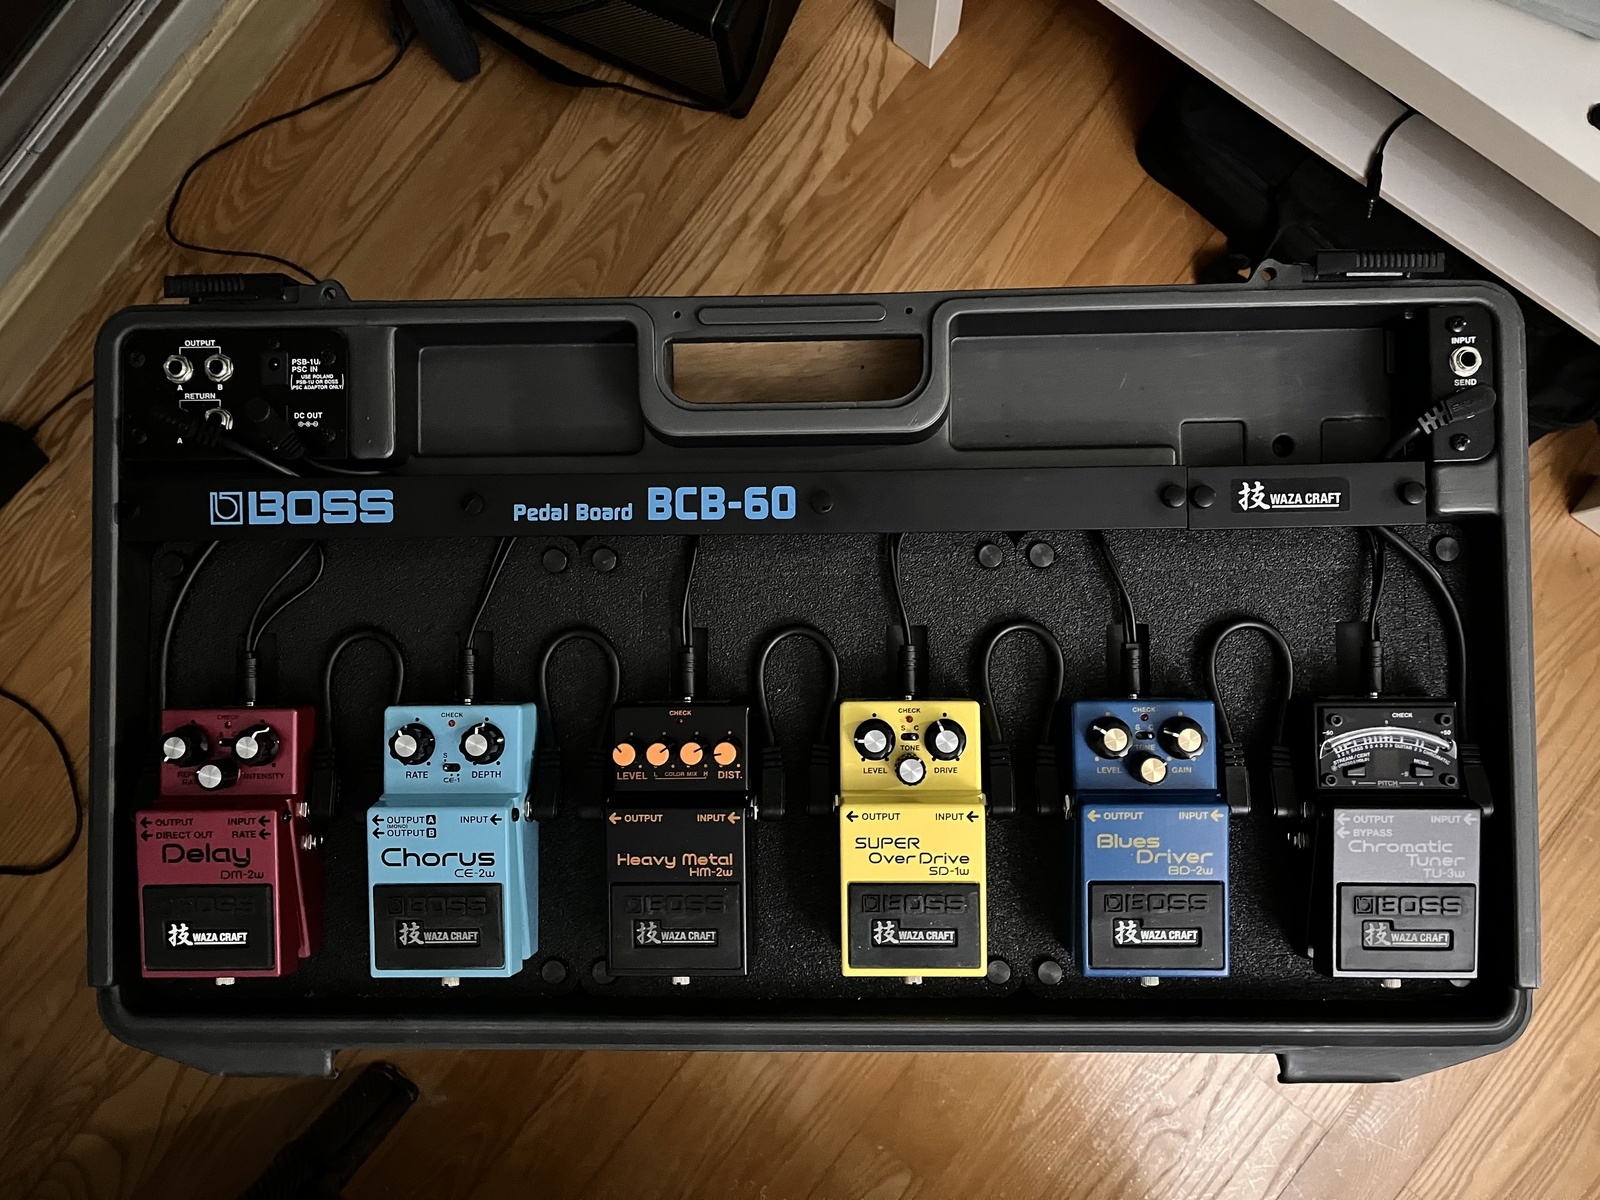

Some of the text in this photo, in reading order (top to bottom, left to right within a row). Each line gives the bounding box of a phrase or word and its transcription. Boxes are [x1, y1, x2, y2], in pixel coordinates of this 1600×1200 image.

[1451, 336, 1476, 344] INPUT
[1454, 378, 1477, 386] SEND
[1238, 480, 1270, 510] 技
[1270, 492, 1341, 504] WAZA CRAFT
[248, 490, 394, 524] BOSS
[513, 486, 796, 522] Pedal Board BCB-60
[617, 772, 648, 780] LEVEL
[718, 771, 743, 779] DIST.
[155, 818, 194, 826] OUTPUT
[228, 818, 256, 826] INPUT
[862, 813, 900, 821] OUTPUT
[156, 831, 213, 839] DIRECT OUT
[1097, 834, 1160, 848] Blues
[855, 837, 920, 849] SUPER
[1348, 840, 1453, 853] Chromatic
[162, 843, 250, 868] Delay
[381, 848, 495, 867] Chorus
[617, 853, 733, 869] Heavy Metal
[1137, 850, 1213, 864] Driver
[1405, 854, 1465, 867] Tuner
[220, 870, 264, 880] DM-2w
[454, 869, 495, 878] CE-2w
[689, 867, 733, 877] HM-2w
[929, 867, 970, 876] SD-1w
[1168, 866, 1213, 875] BD-2w
[1423, 869, 1465, 878] TU-3w
[406, 896, 486, 914] BOSS
[884, 894, 967, 914] BOSS
[1125, 894, 1208, 913] BOSS
[1378, 896, 1462, 916] BOSS
[168, 923, 193, 946] 技
[192, 932, 248, 942] WAZA CRAFT
[399, 922, 424, 946] 技
[424, 931, 478, 941] WAZA CRAFT
[637, 922, 661, 945] 技
[661, 931, 716, 940] WAZA CRAFT
[873, 921, 899, 945] 技
[898, 930, 954, 940] WAZA CRAFT
[1115, 920, 1141, 944] 技
[1140, 930, 1198, 940] WAZA CRAFT
[1365, 922, 1391, 946] 技
[1391, 932, 1449, 942] WAZA CRAFT
